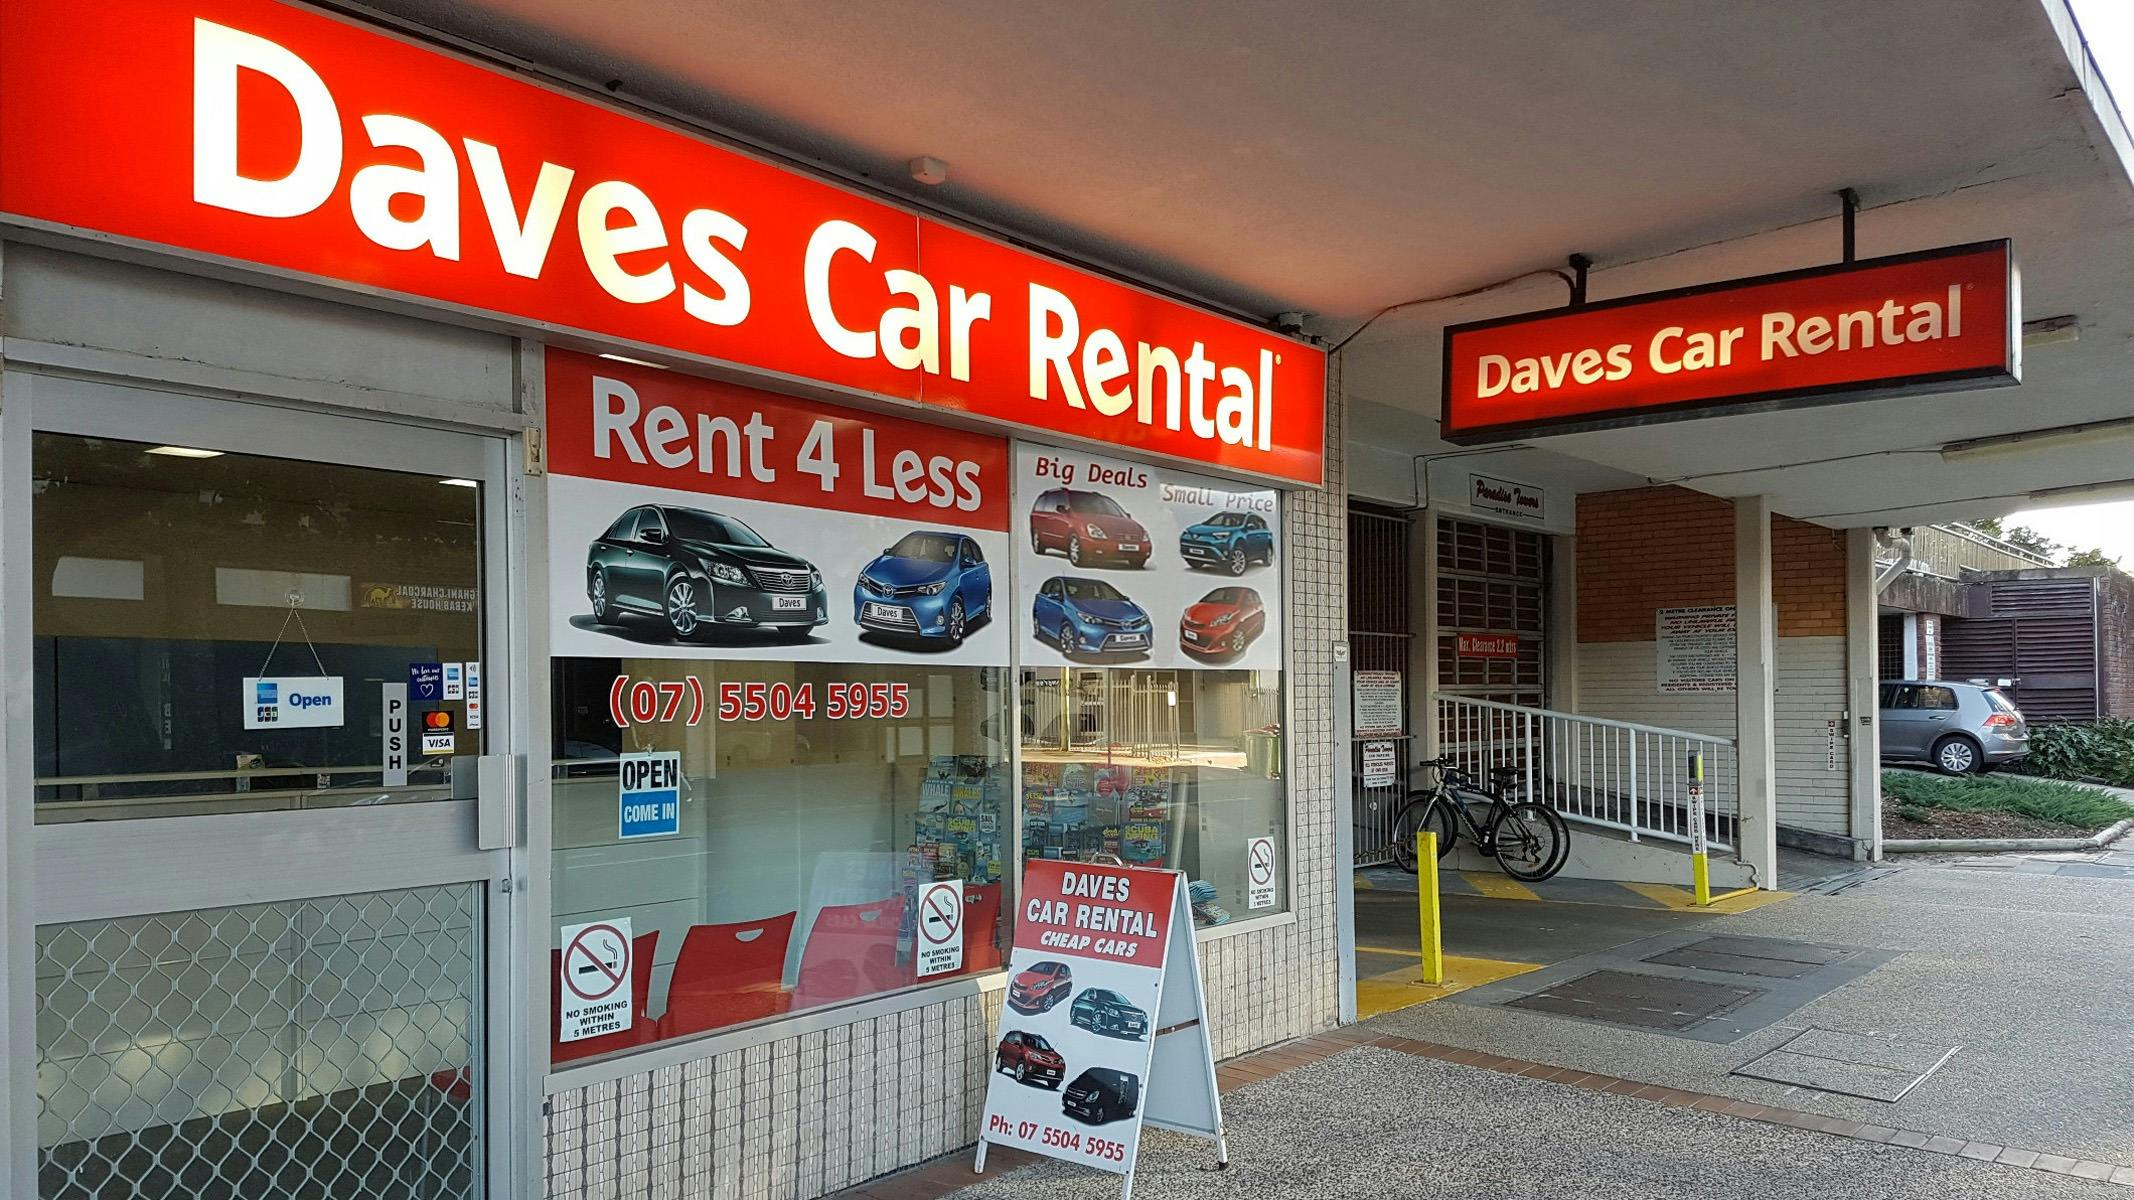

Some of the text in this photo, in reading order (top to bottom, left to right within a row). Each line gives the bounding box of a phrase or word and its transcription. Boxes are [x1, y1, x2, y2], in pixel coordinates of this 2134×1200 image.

[194, 17, 1273, 452] Daves Car Rental
[1477, 283, 1962, 399] Daves Car Rental
[592, 374, 982, 512] Rent 4 Less
[1035, 456, 1148, 489] Big Deals
[1162, 483, 1274, 513] Small Price
[1475, 479, 1539, 509] Paradise Towers
[1495, 507, 1523, 517] ENTRANCE
[778, 597, 801, 608] Daves
[877, 606, 898, 618] Daves
[1472, 637, 1496, 653] Clearance
[289, 692, 332, 709] Open
[610, 675, 909, 728] (07) 5504 5955
[389, 699, 402, 770] PUSH
[427, 738, 451, 748] VISA
[622, 759, 678, 791] OPEN
[623, 802, 675, 824] COME IN
[1125, 825, 1159, 834] SCUBA
[1061, 871, 1131, 903] DAVES
[1027, 898, 1158, 938] CAR RENTAL
[931, 945, 960, 957] SMOKING
[1040, 930, 1138, 958] CHEAP CARS
[930, 955, 952, 964] WITHIN
[931, 962, 955, 972] METRES
[566, 1000, 628, 1020] NO SMOKING
[579, 1012, 615, 1026] WITHIN
[573, 1021, 621, 1038] 5 METRES
[989, 1114, 1125, 1162] Ph: 07 5504 5955
